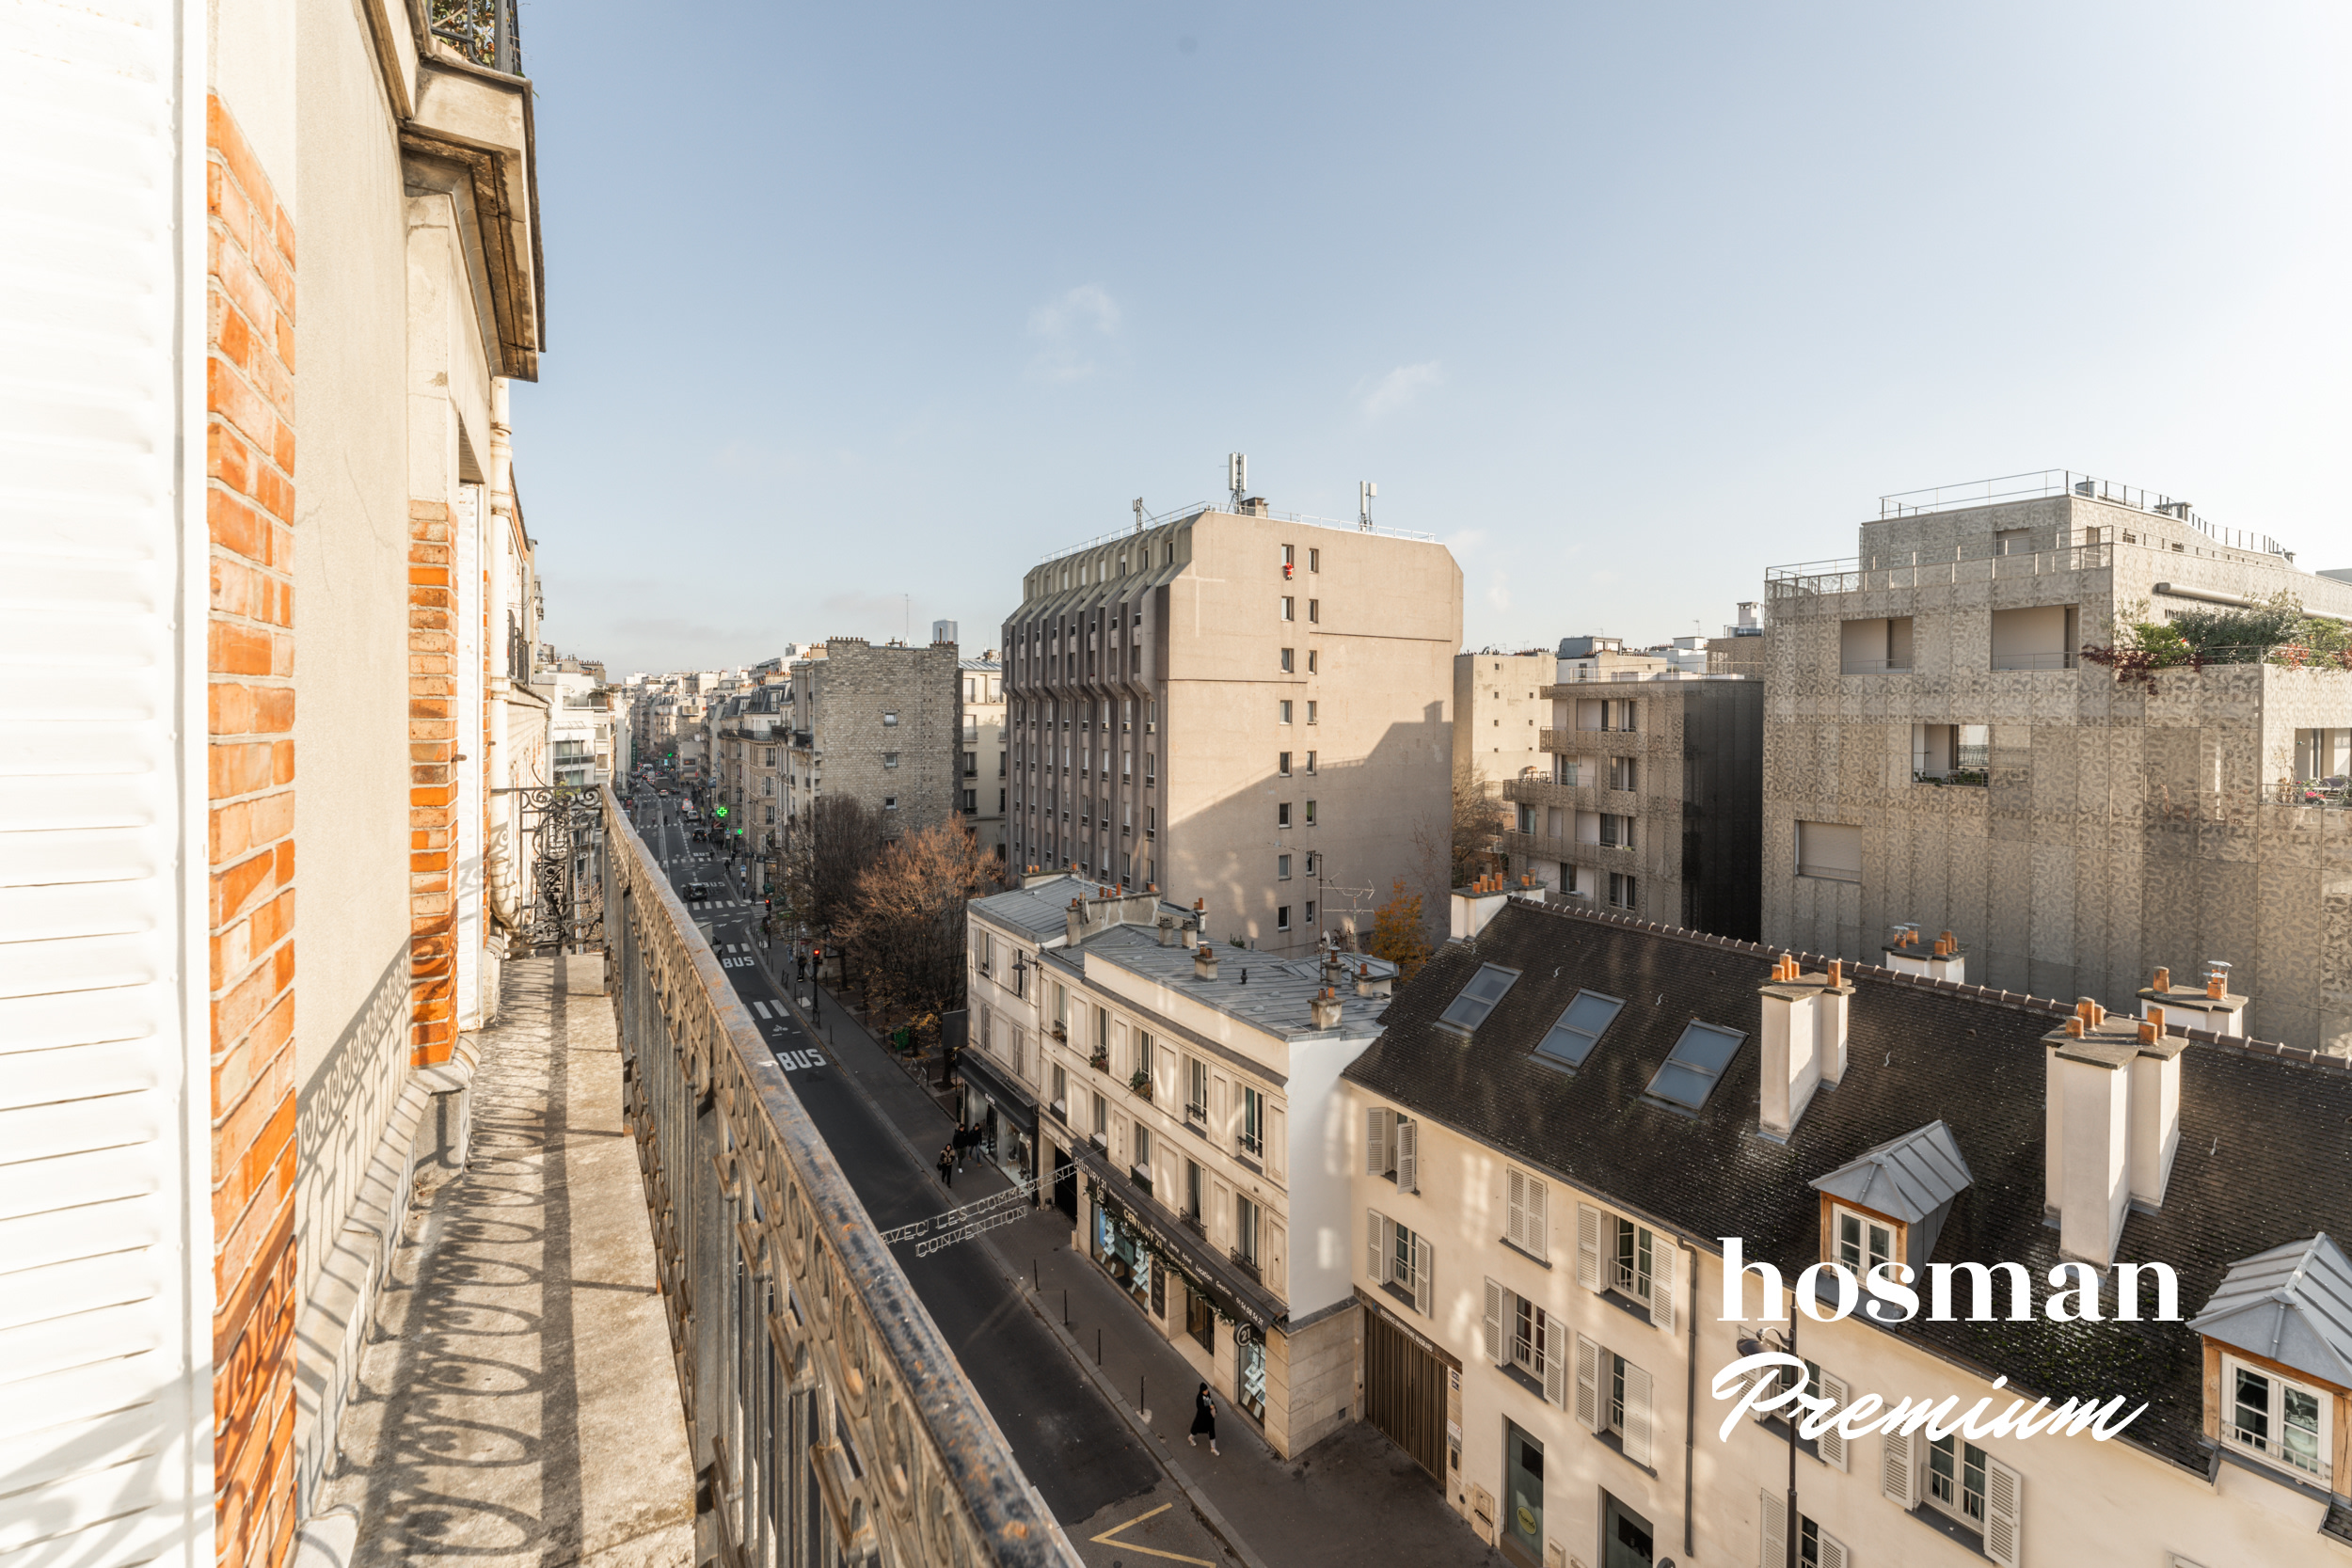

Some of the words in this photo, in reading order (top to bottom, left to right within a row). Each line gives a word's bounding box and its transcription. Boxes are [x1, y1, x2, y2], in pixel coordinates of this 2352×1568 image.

[723, 956, 755, 969] BUS
[776, 1049, 827, 1071] BUS
[937, 1206, 968, 1230] LES
[1074, 1156, 1101, 1183] CENTURY
[1101, 1180, 1107, 1190] 21
[1196, 1264, 1213, 1282] Location
[1216, 1280, 1232, 1297] Gestion
[1123, 1209, 1154, 1241] CENTURY
[1155, 1237, 1163, 1250] 21
[917, 1205, 1027, 1258] CONVENTION
[1241, 1327, 1250, 1341] 21
